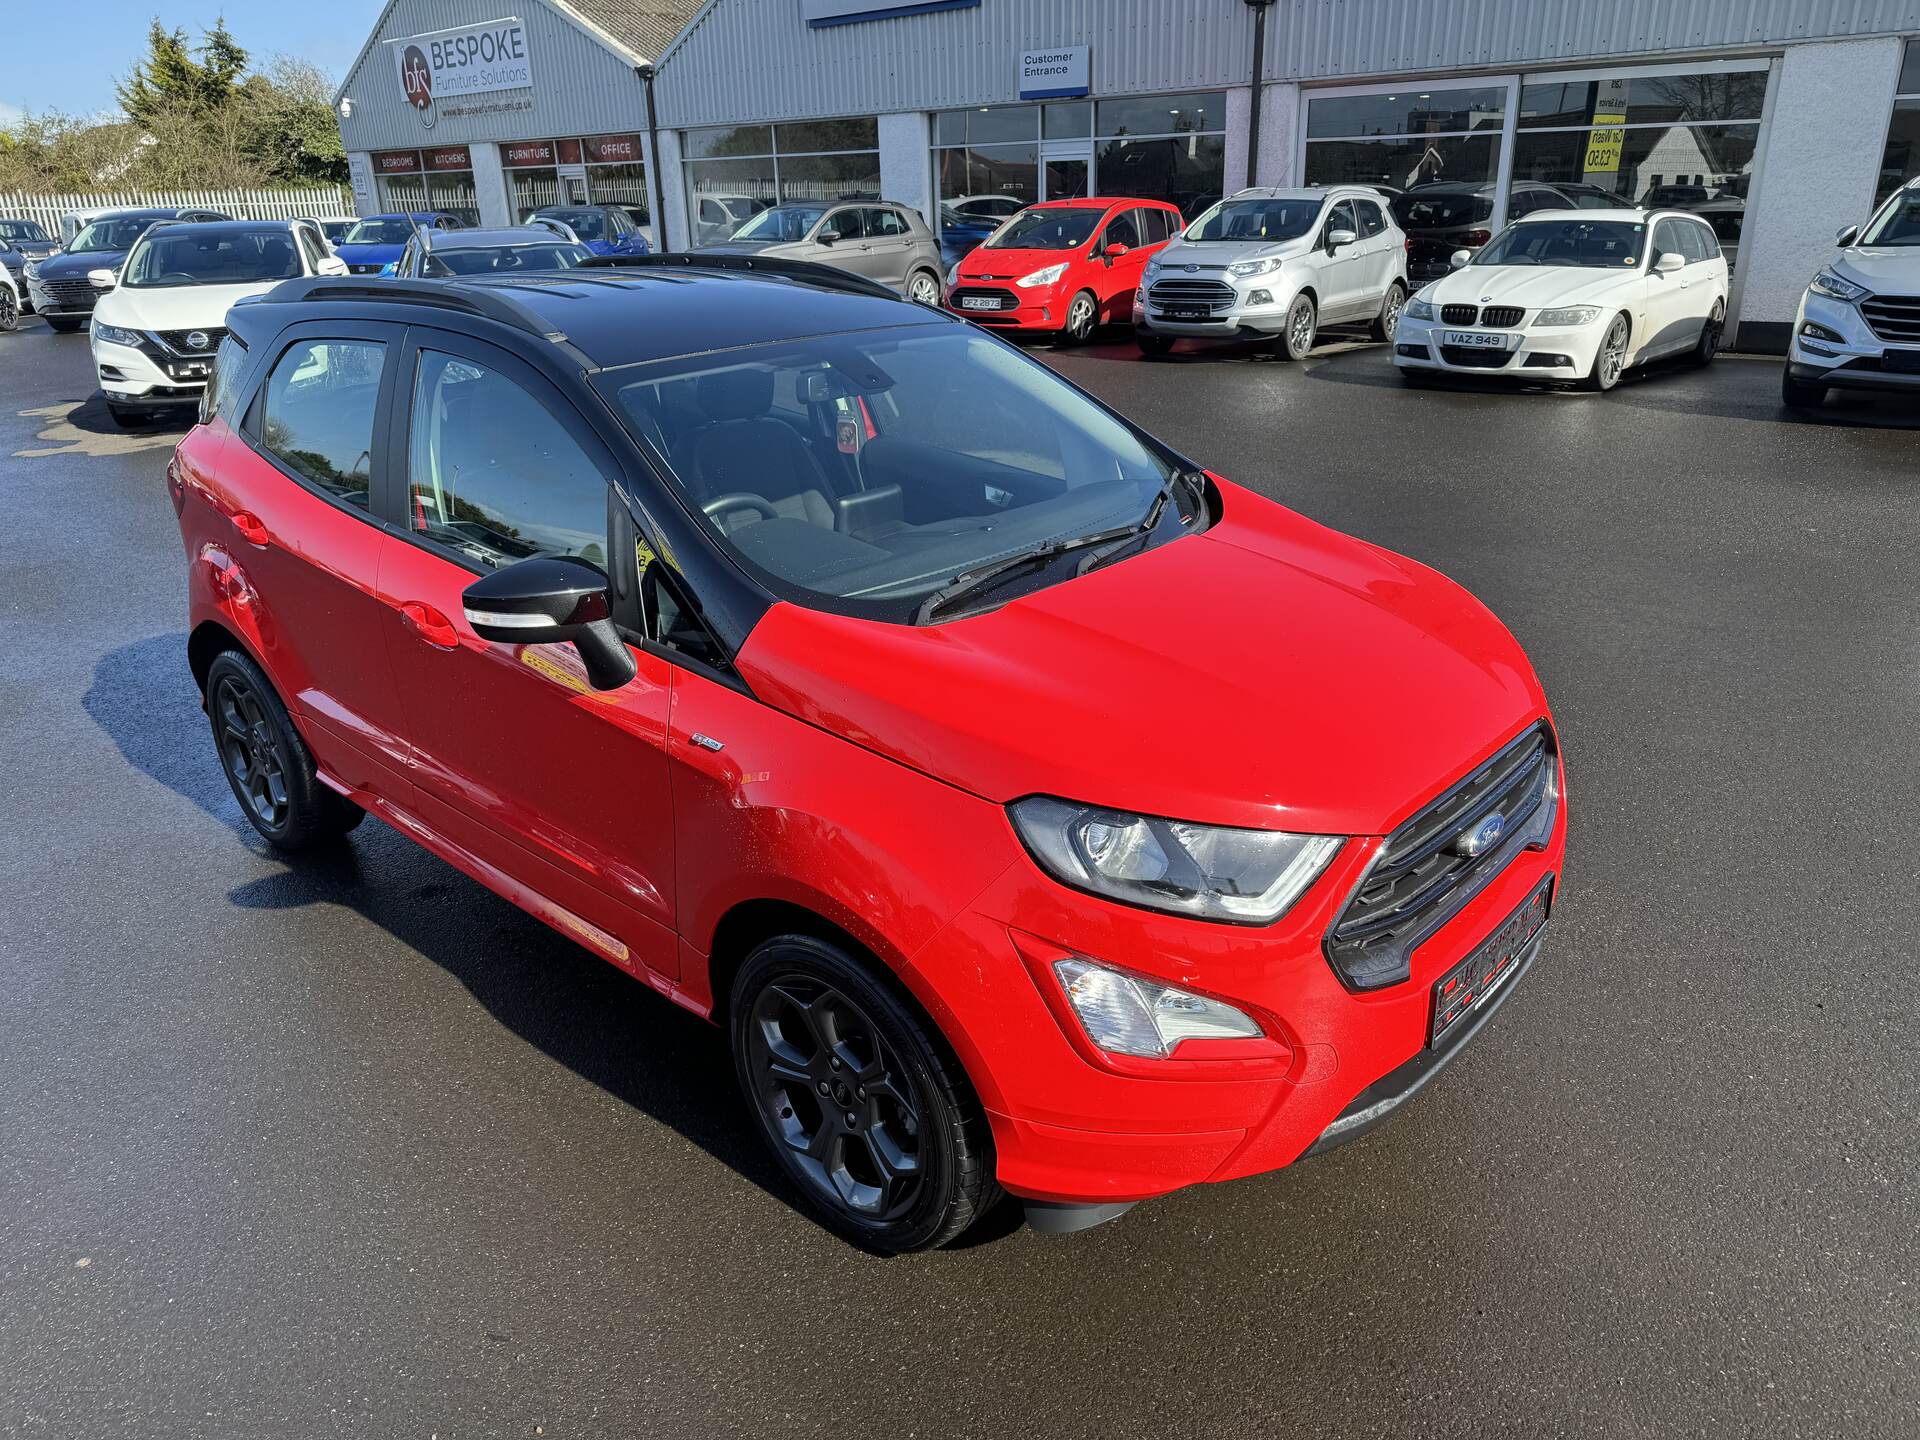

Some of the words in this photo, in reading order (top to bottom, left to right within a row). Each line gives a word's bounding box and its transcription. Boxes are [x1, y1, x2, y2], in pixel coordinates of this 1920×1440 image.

[430, 27, 524, 70] BESPOKE
[1024, 53, 1073, 65] Customer
[1024, 66, 1068, 77] Entrance
[435, 74, 479, 92] Furniture
[480, 67, 527, 87] Solutions
[400, 46, 436, 128] bfs
[508, 147, 550, 160] FURNITURE
[601, 142, 631, 156] OFFICE
[381, 156, 414, 168] BEDROOMS
[434, 153, 466, 165] KITCHENS
[979, 299, 1000, 308] 2873
[1451, 334, 1473, 344] VAZ
[1475, 336, 1500, 345] 949
